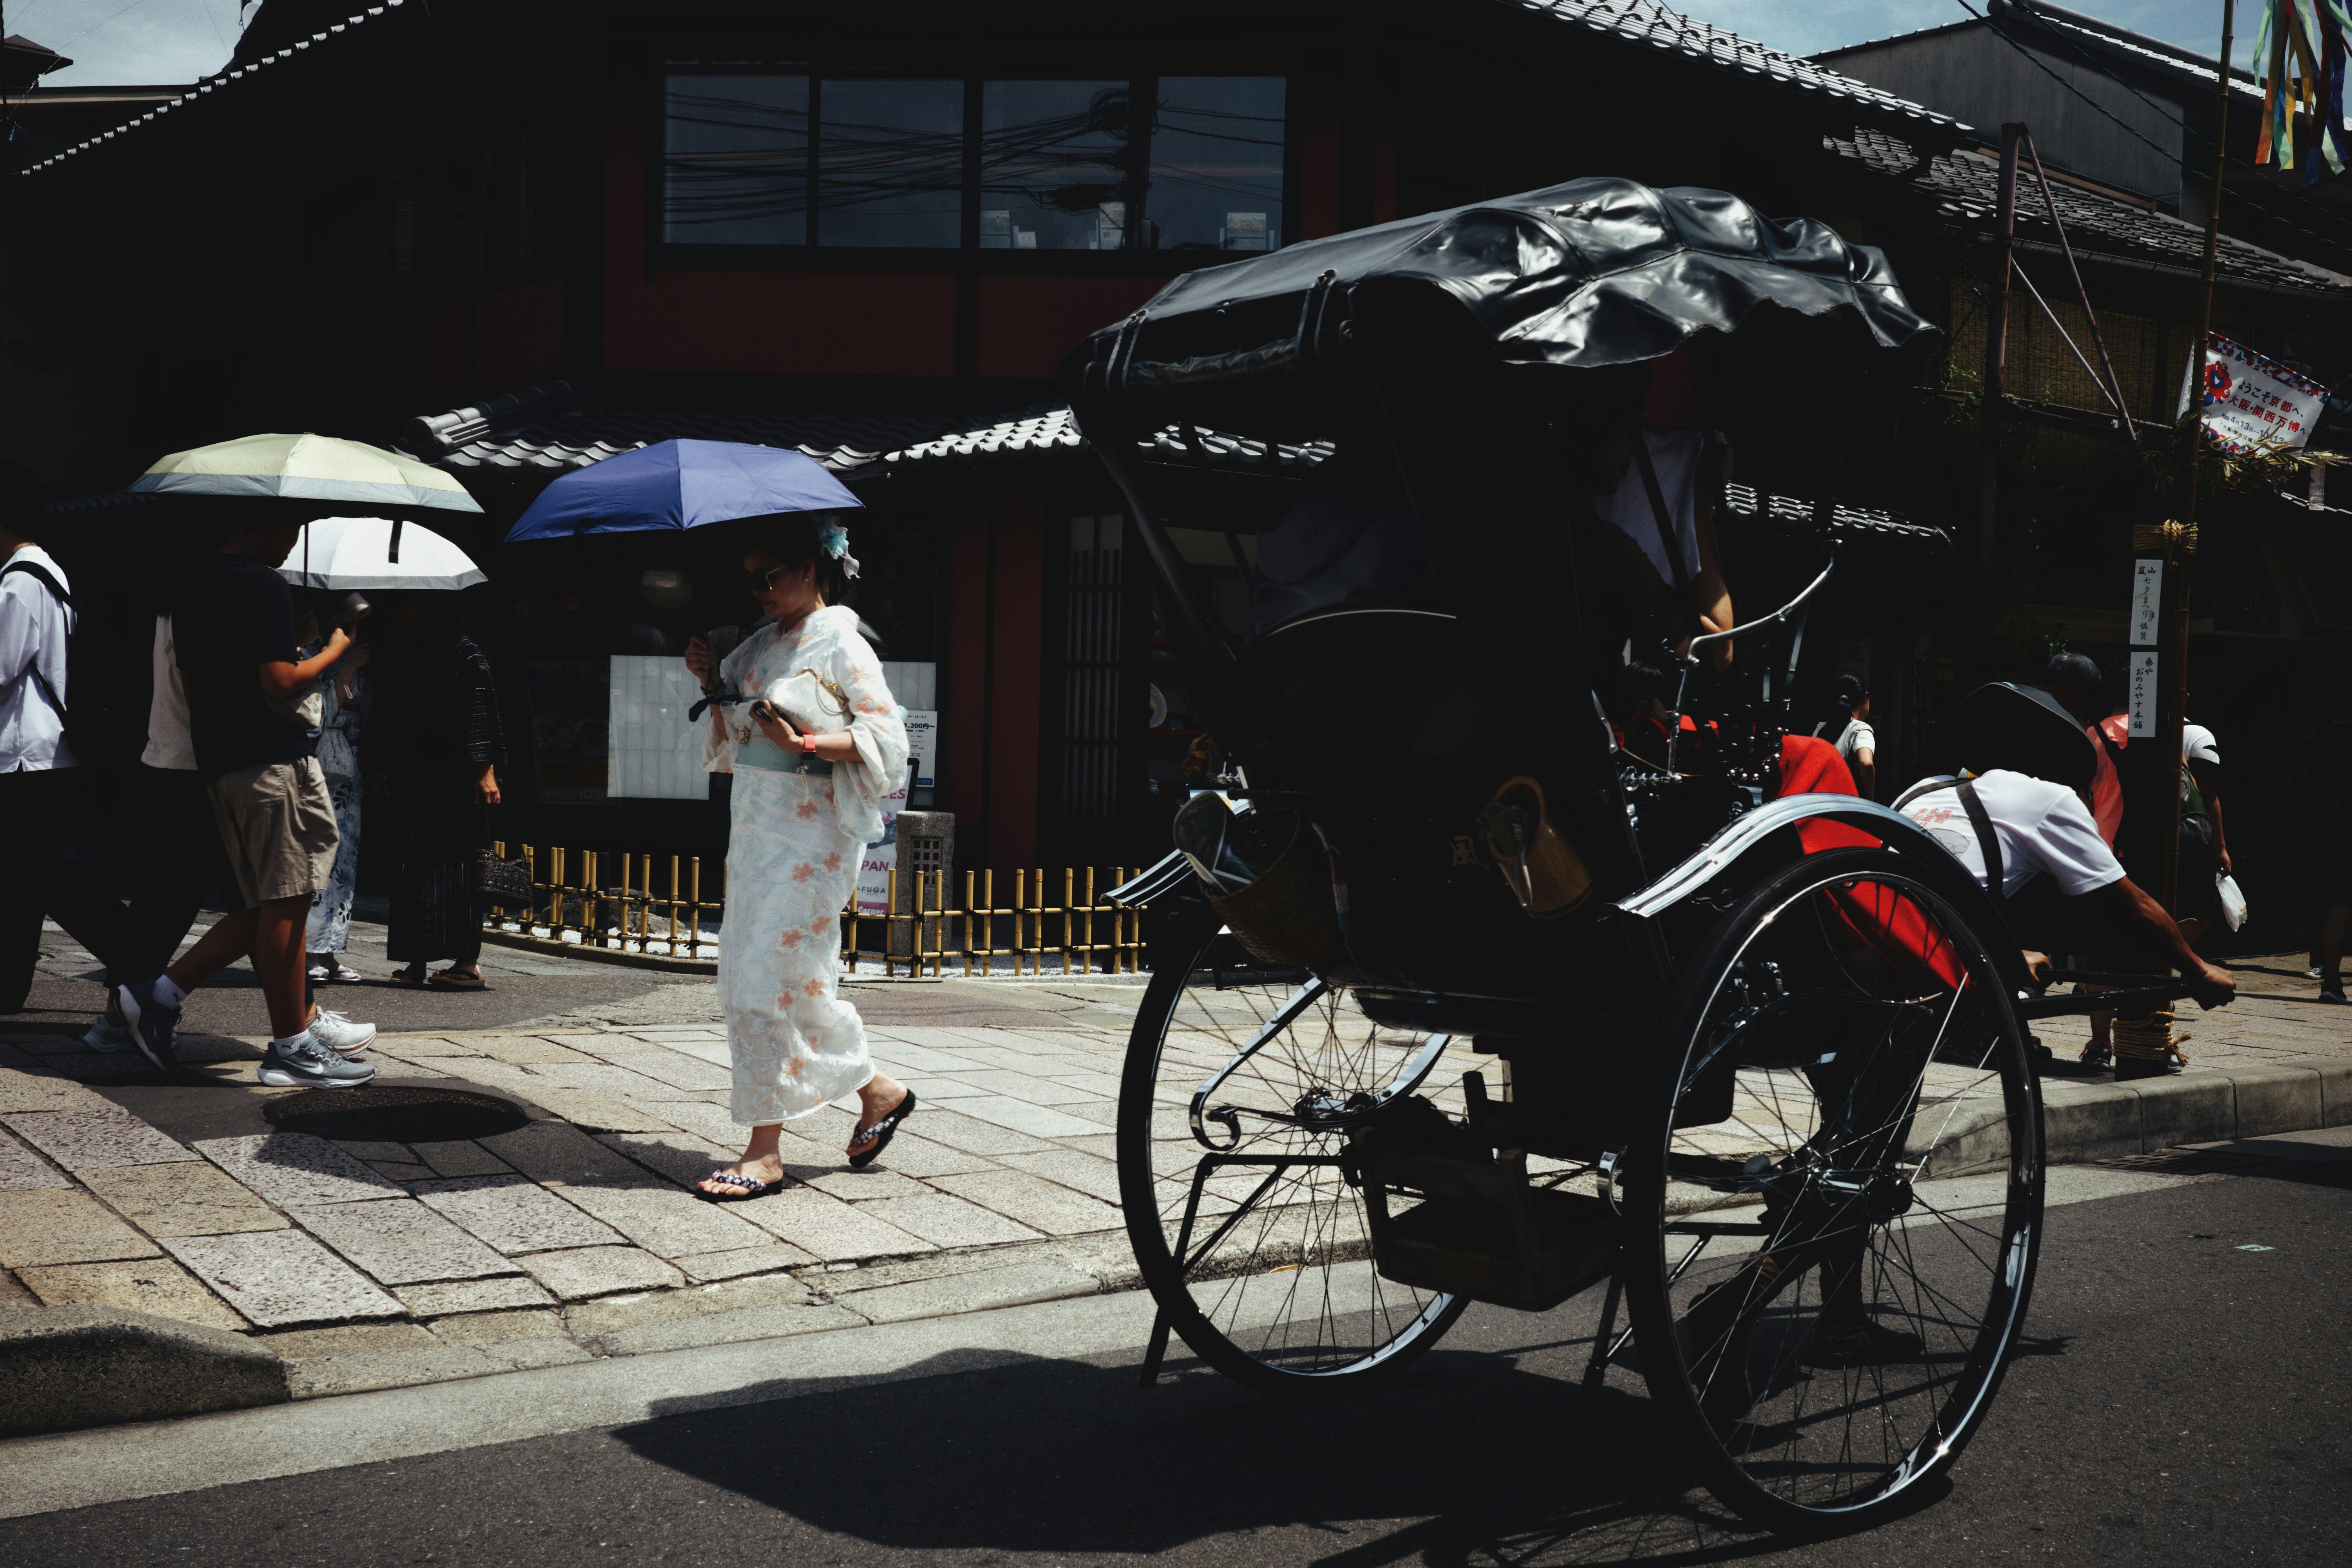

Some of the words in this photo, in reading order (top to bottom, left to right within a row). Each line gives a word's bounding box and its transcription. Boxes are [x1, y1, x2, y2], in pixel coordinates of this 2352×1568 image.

[2238, 380, 2303, 417] ようこそ京都へ、
[2228, 394, 2305, 435] 大阪・関西万博へ
[2138, 566, 2156, 575] 嵐山
[2145, 657, 2153, 675] 桑や
[881, 789, 906, 799] ES
[858, 906, 884, 915] Corner
